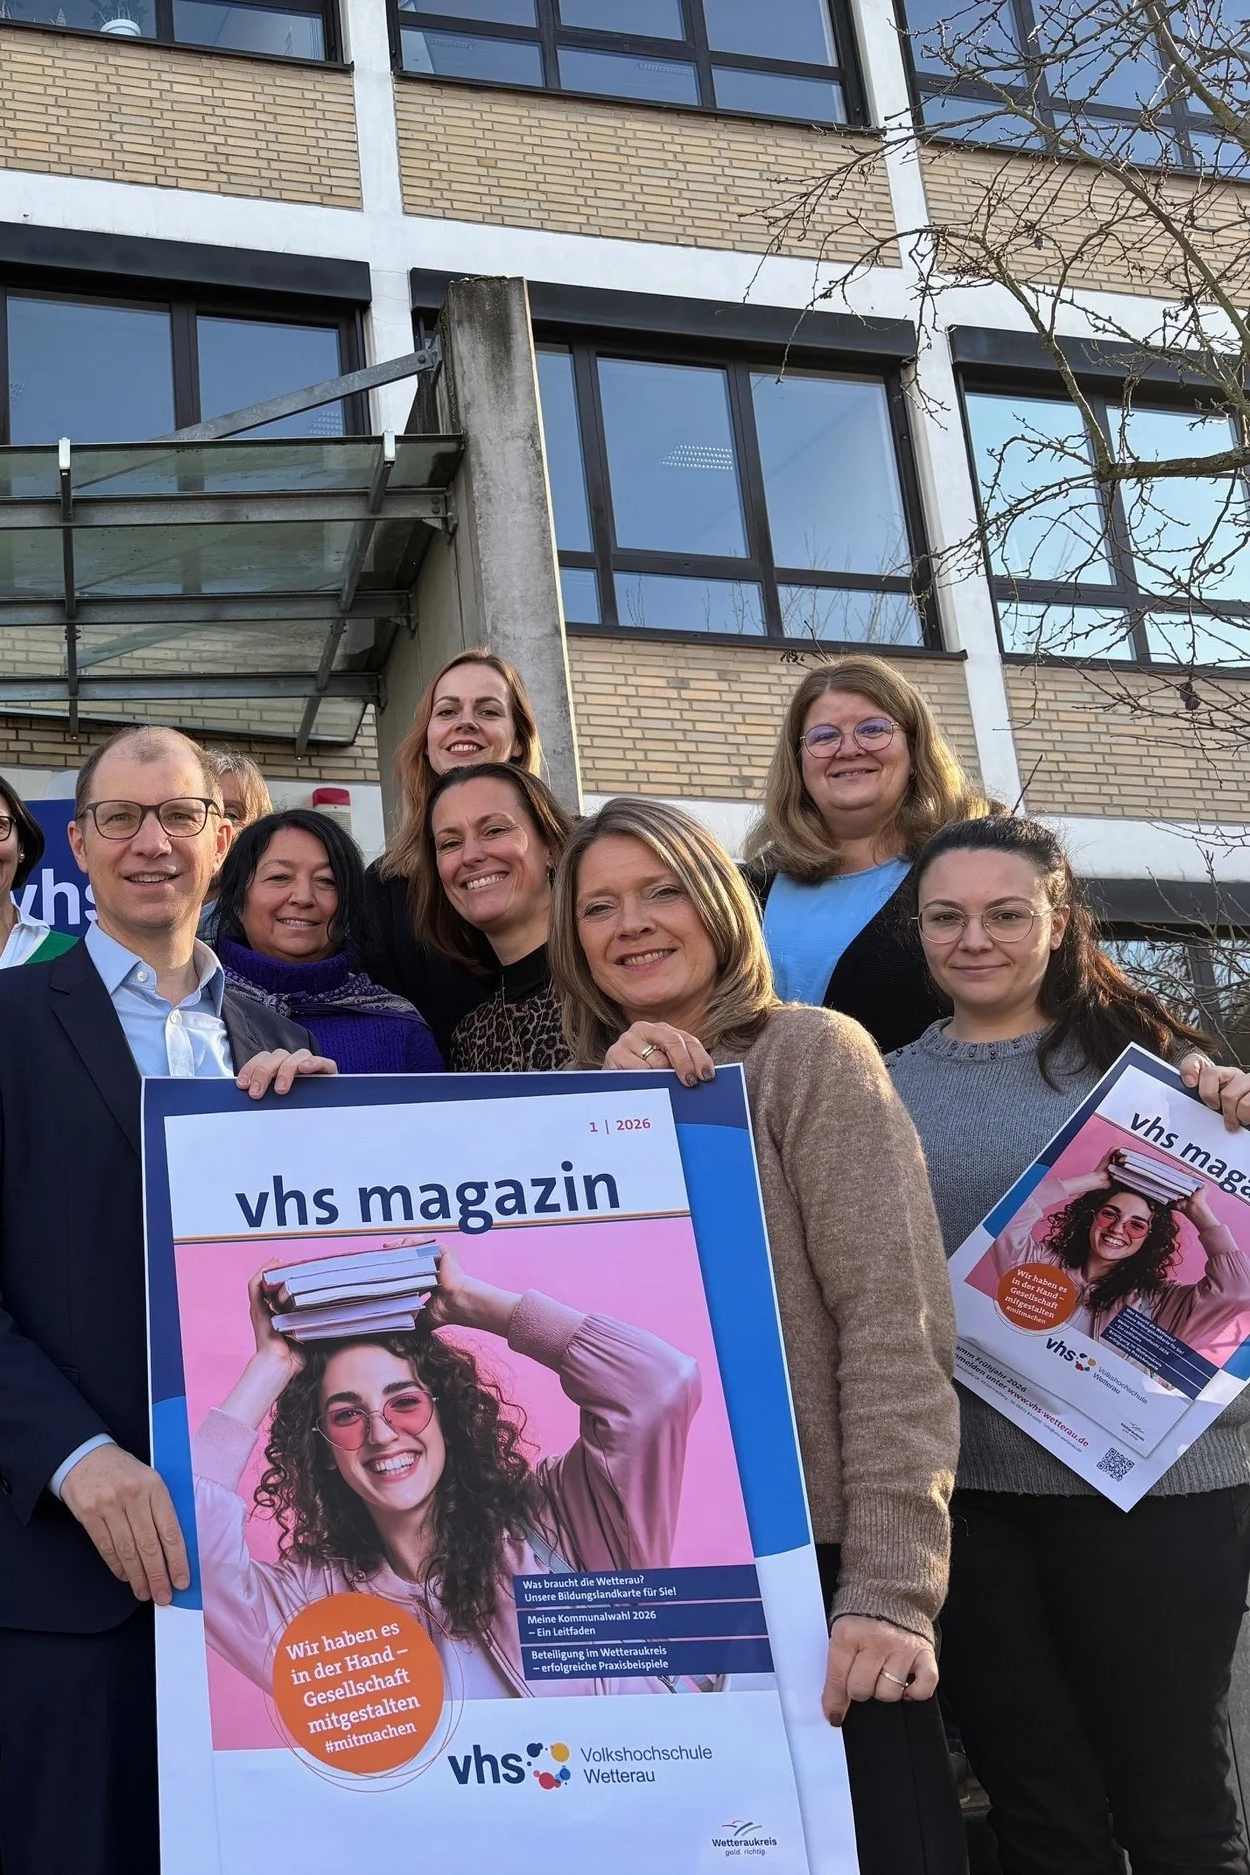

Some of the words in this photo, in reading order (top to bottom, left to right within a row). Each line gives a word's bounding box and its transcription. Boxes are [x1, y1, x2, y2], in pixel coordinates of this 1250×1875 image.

[589, 1121, 599, 1134] 1
[616, 1118, 651, 1132] 2026
[1130, 1112, 1179, 1149] vhs
[234, 1175, 339, 1228] vhs
[358, 1160, 621, 1235] magazin
[1011, 1277, 1021, 1286] in
[1021, 1282, 1036, 1291] der
[1036, 1286, 1059, 1300] Hand
[1017, 1269, 1033, 1280] Wir
[1032, 1275, 1058, 1290] haben
[1005, 1296, 1055, 1319] mitgestalten
[1010, 1287, 1058, 1310] Gesellschaft
[1006, 1305, 1047, 1325] #mitmachen
[1045, 1337, 1077, 1362] vhs
[974, 1357, 1007, 1380] Frühjahr
[1007, 1378, 1028, 1393] 2026
[1093, 1372, 1121, 1395] Wetterau
[1098, 1366, 1148, 1404] Volkshochschule
[955, 1353, 986, 1376] nmelden
[986, 1374, 1008, 1390] unter
[1007, 1387, 1089, 1447] www.vhs-wetterau.de
[523, 1580, 543, 1590] Was
[544, 1578, 578, 1589] braucht
[580, 1577, 595, 1587] die
[595, 1575, 645, 1586] Wetterau?
[524, 1593, 557, 1603] Unsere
[558, 1588, 642, 1602] Bildungslandkarte
[643, 1588, 657, 1597] für
[658, 1586, 677, 1596] Sie!
[527, 1614, 557, 1625] Meine
[558, 1611, 631, 1623] Kommunalwahl
[632, 1610, 657, 1620] 2026
[286, 1640, 320, 1661] Wir
[321, 1628, 378, 1652] haben
[381, 1622, 400, 1637] es
[536, 1628, 551, 1637] Ein
[553, 1627, 596, 1637] Leitfaden
[291, 1669, 312, 1685] in
[314, 1663, 343, 1680] der
[344, 1645, 395, 1672] Hand
[531, 1649, 585, 1661] Beteiligung
[586, 1649, 599, 1658] im
[600, 1646, 667, 1658] Wetteraukreis
[541, 1662, 597, 1675] erfolgreiche
[599, 1659, 669, 1671] Praxisbeispiele
[303, 1668, 411, 1707] Gesellschaft
[307, 1695, 421, 1734] mitgestalten
[325, 1722, 417, 1754] #mitmachen
[447, 1744, 526, 1785] vhs
[580, 1744, 713, 1763] Volkshochschule
[583, 1768, 656, 1784] Wetterau
[712, 1837, 778, 1847] Wetteraukreis
